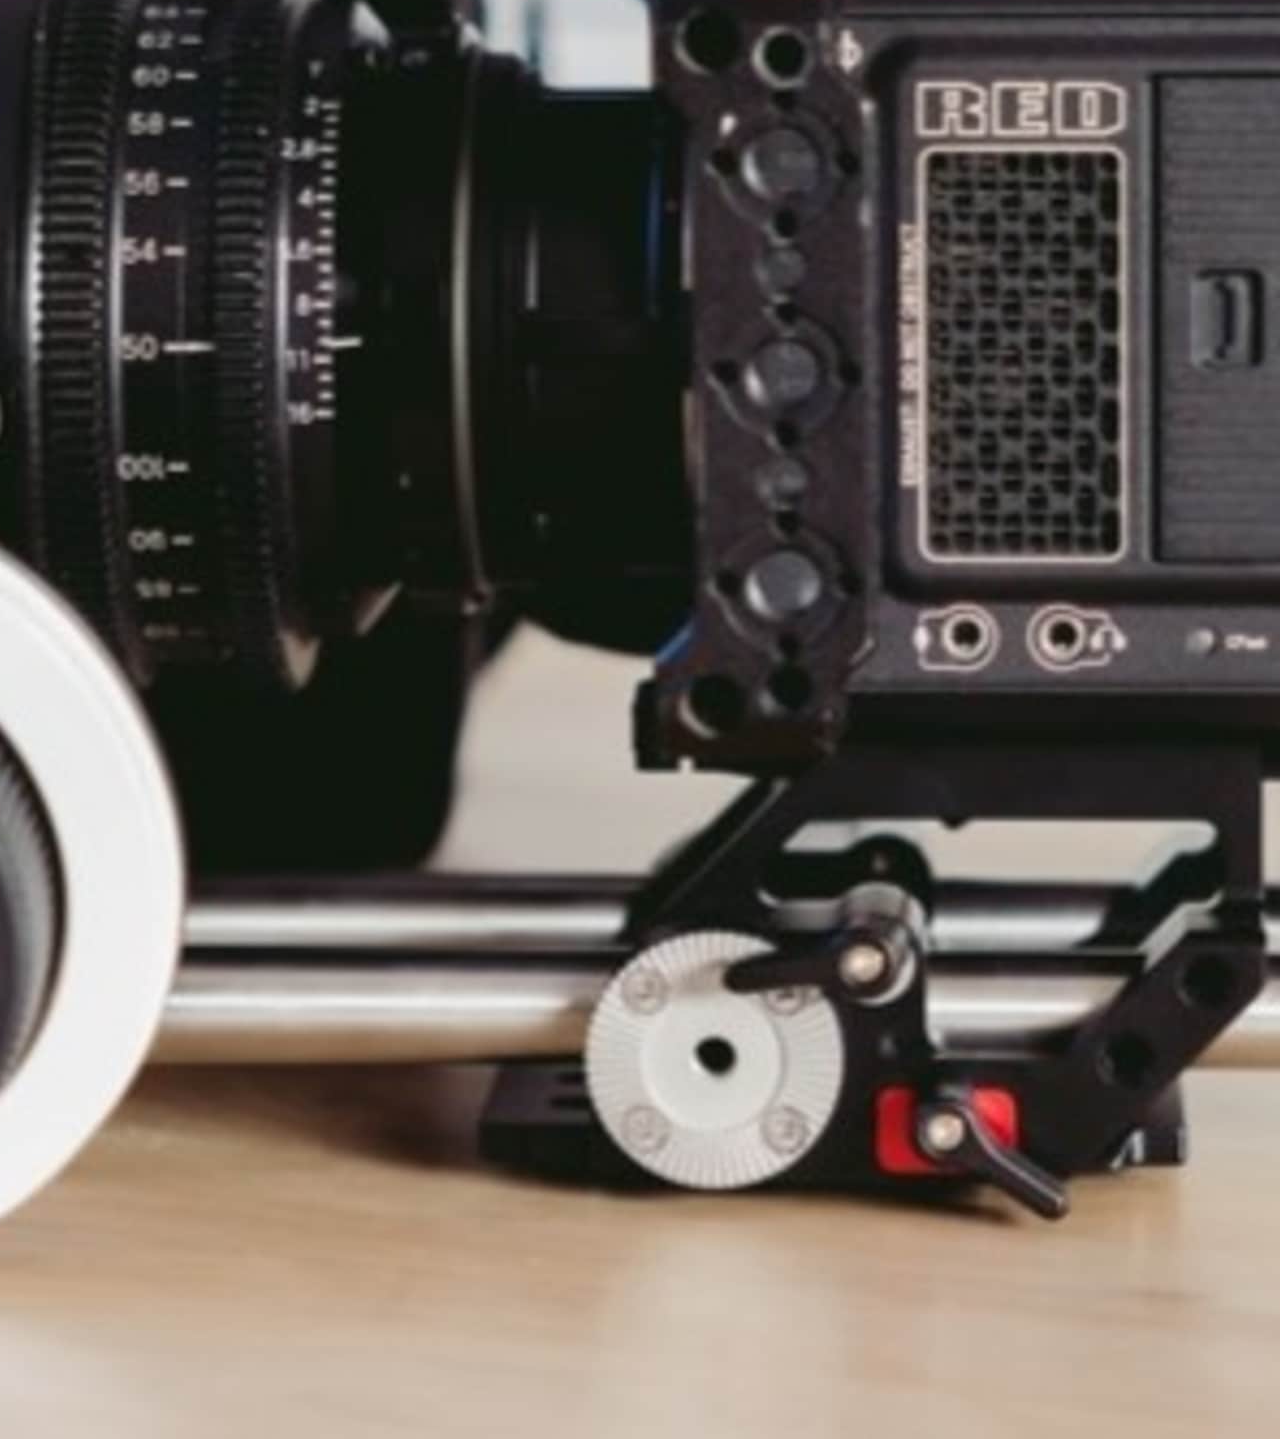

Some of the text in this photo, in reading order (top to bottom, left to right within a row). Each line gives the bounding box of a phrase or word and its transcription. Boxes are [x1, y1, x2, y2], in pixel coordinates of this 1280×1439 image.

[136, 31, 173, 50] 62
[131, 65, 170, 88] 60
[914, 80, 1128, 138] RED
[127, 112, 165, 136] 58
[124, 169, 160, 196] 56
[296, 185, 315, 207] 4
[118, 236, 158, 265] 54
[118, 333, 160, 361] 50
